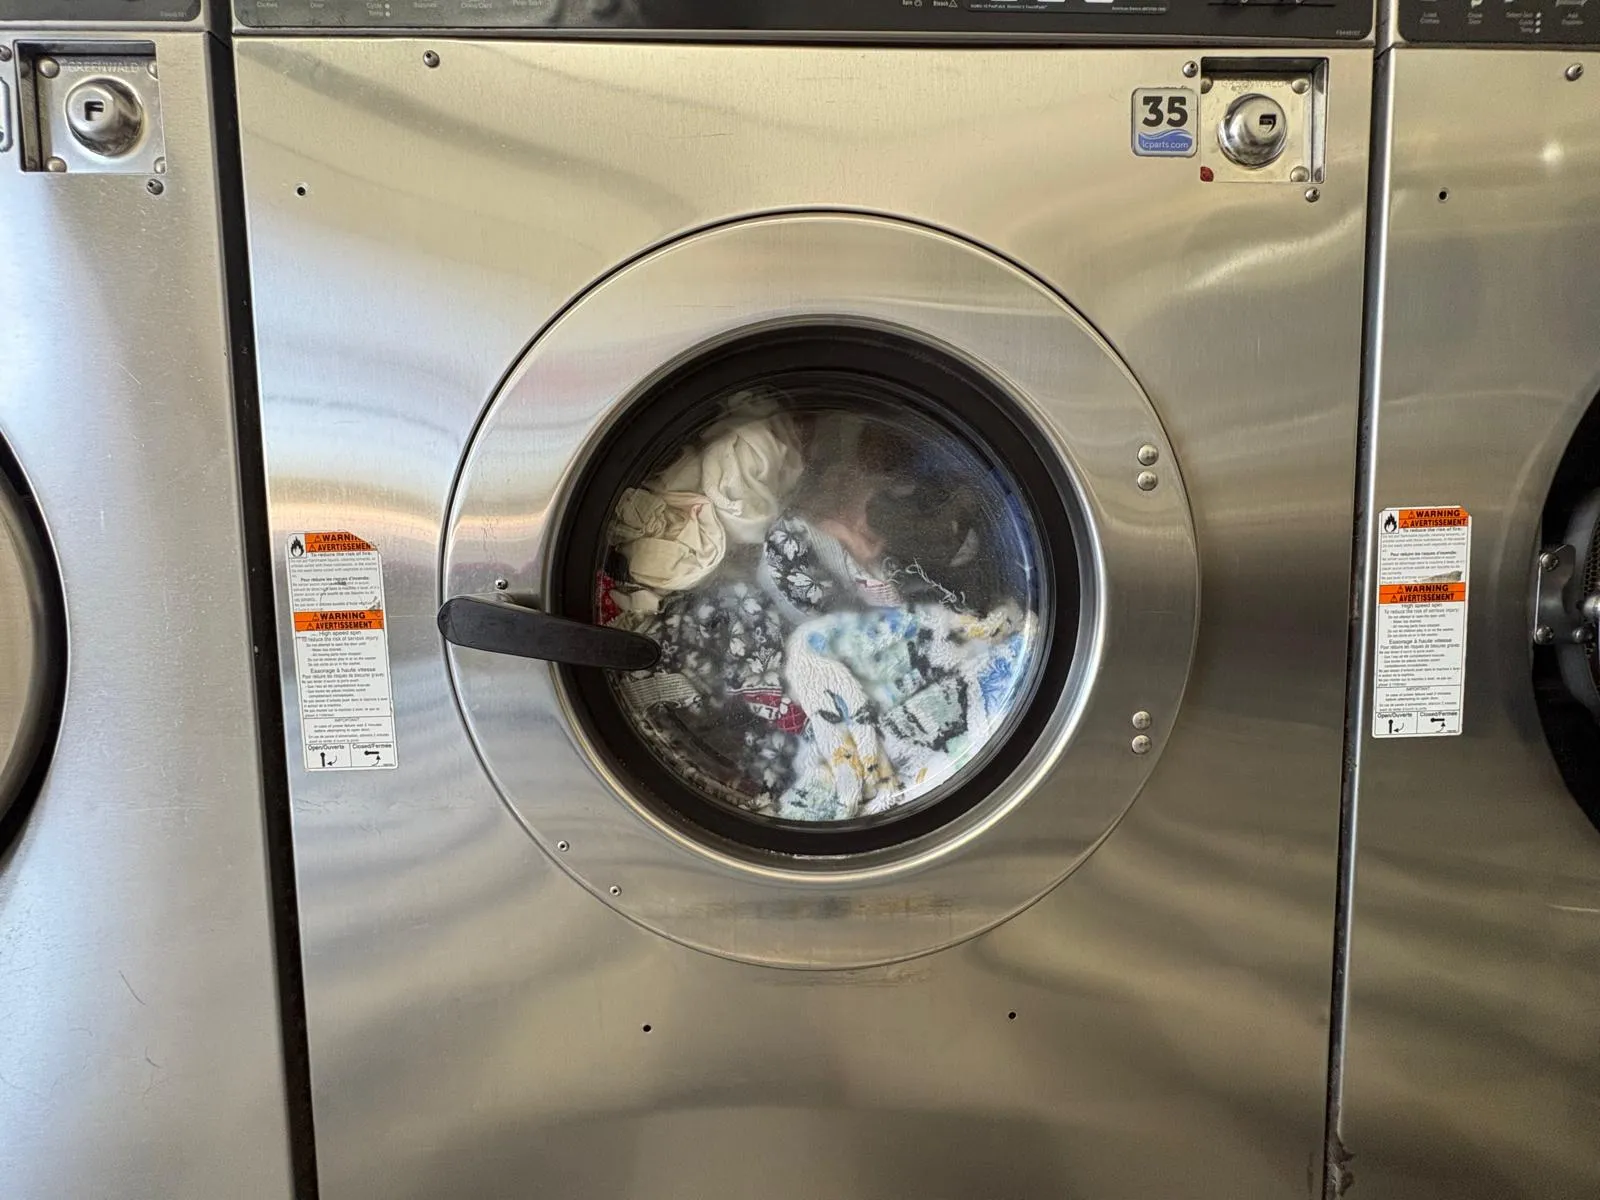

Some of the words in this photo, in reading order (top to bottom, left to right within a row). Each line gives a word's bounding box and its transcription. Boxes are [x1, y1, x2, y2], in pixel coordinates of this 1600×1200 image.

[1142, 96, 1188, 127] 35
[1410, 519, 1466, 527] AVERTISSEMENT
[1399, 594, 1454, 602] AVERTISSEMENT
[316, 621, 372, 629] AVERTISSEMENT
